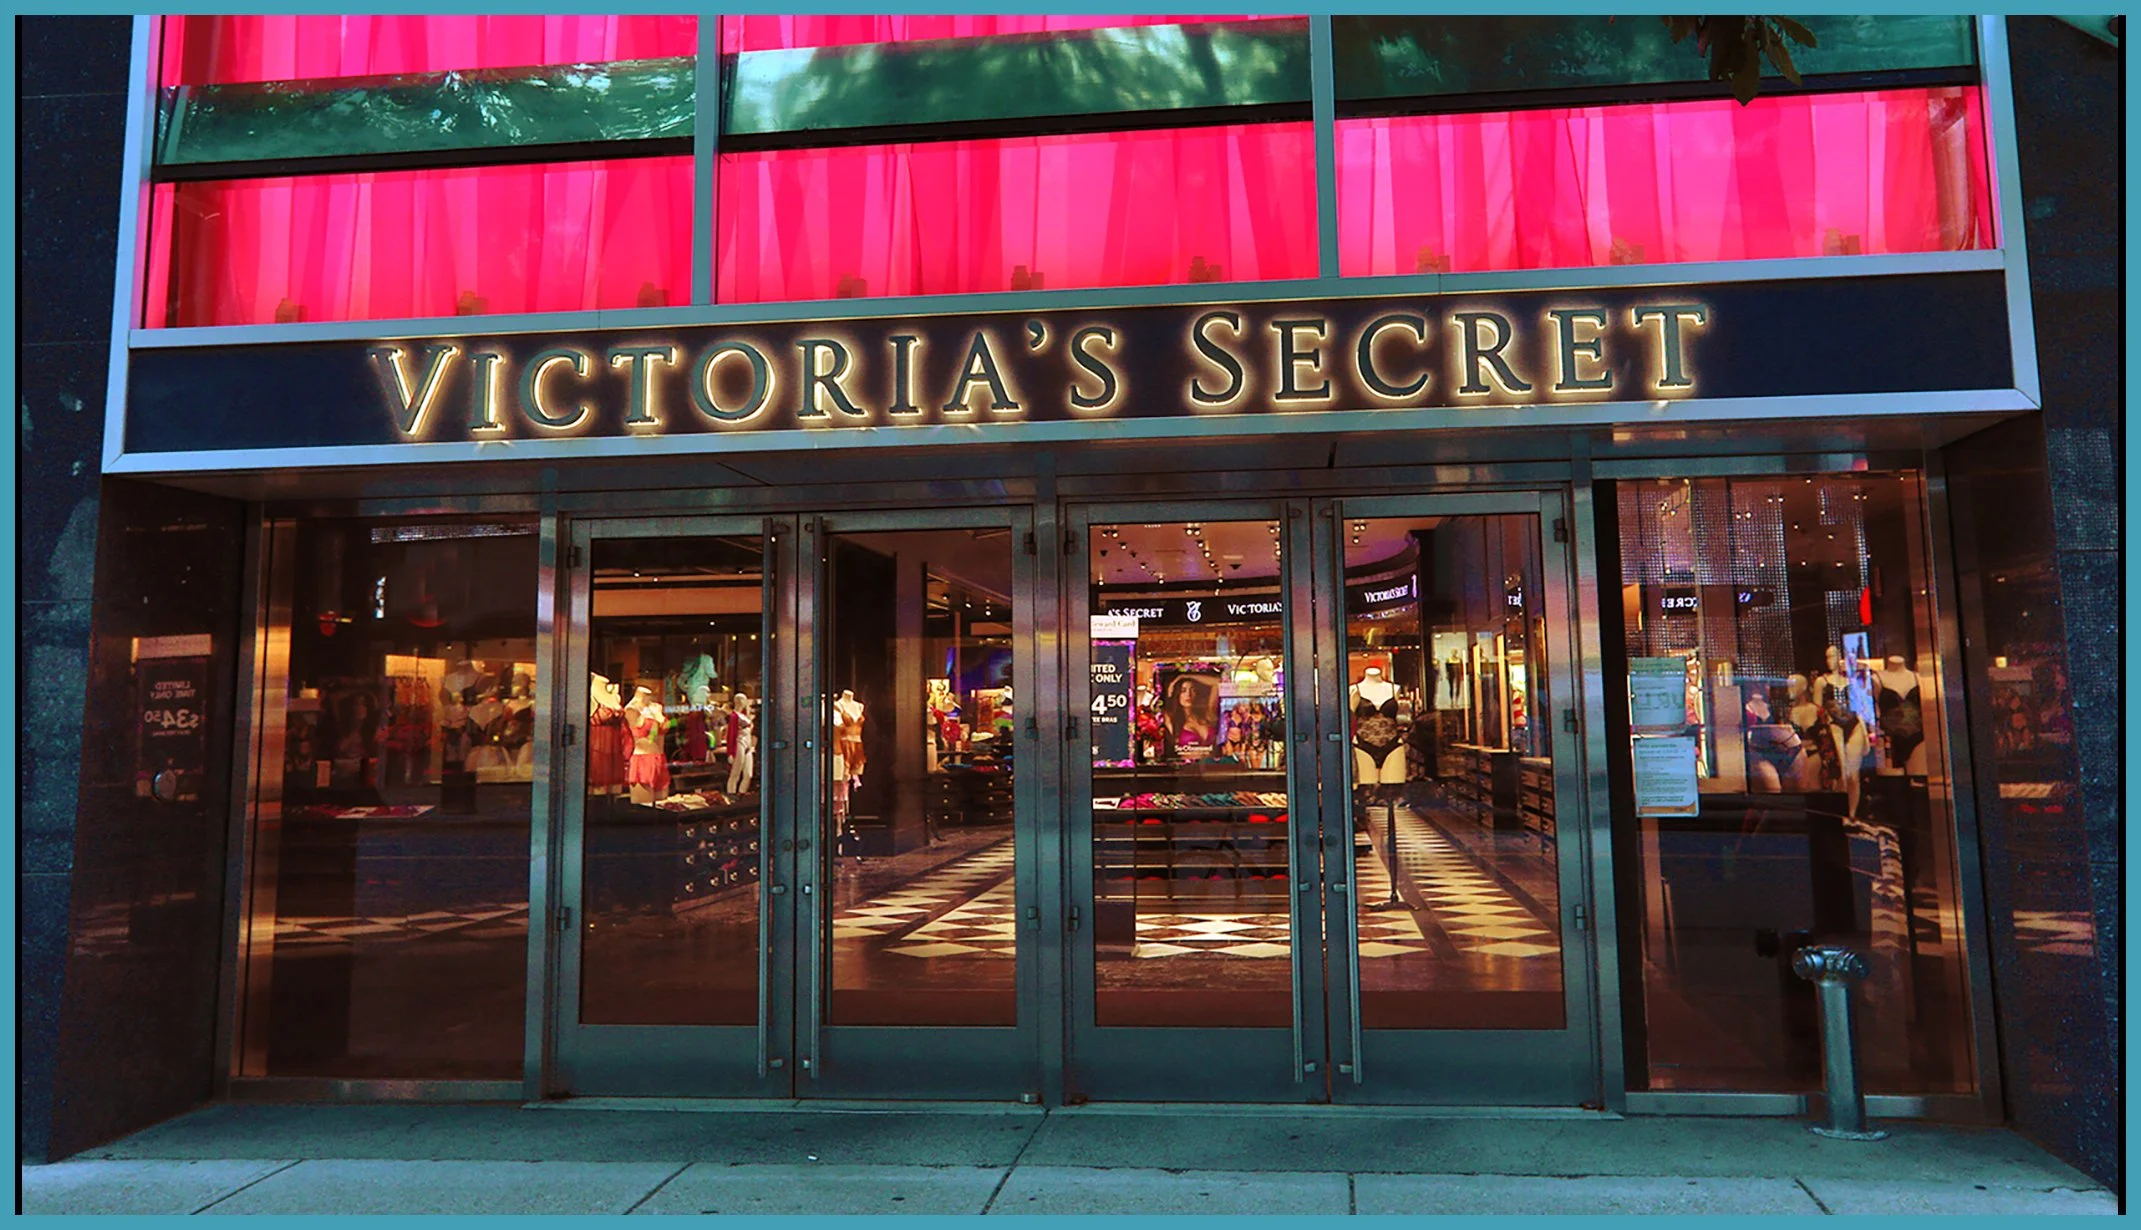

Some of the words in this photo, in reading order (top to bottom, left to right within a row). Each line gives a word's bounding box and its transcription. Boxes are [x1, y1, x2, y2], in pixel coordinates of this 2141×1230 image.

[371, 320, 1120, 436] VICTORIA'S
[1190, 303, 1707, 405] SECRET
[1123, 608, 1164, 618] SECRET
[1095, 674, 1122, 683] ONLY
